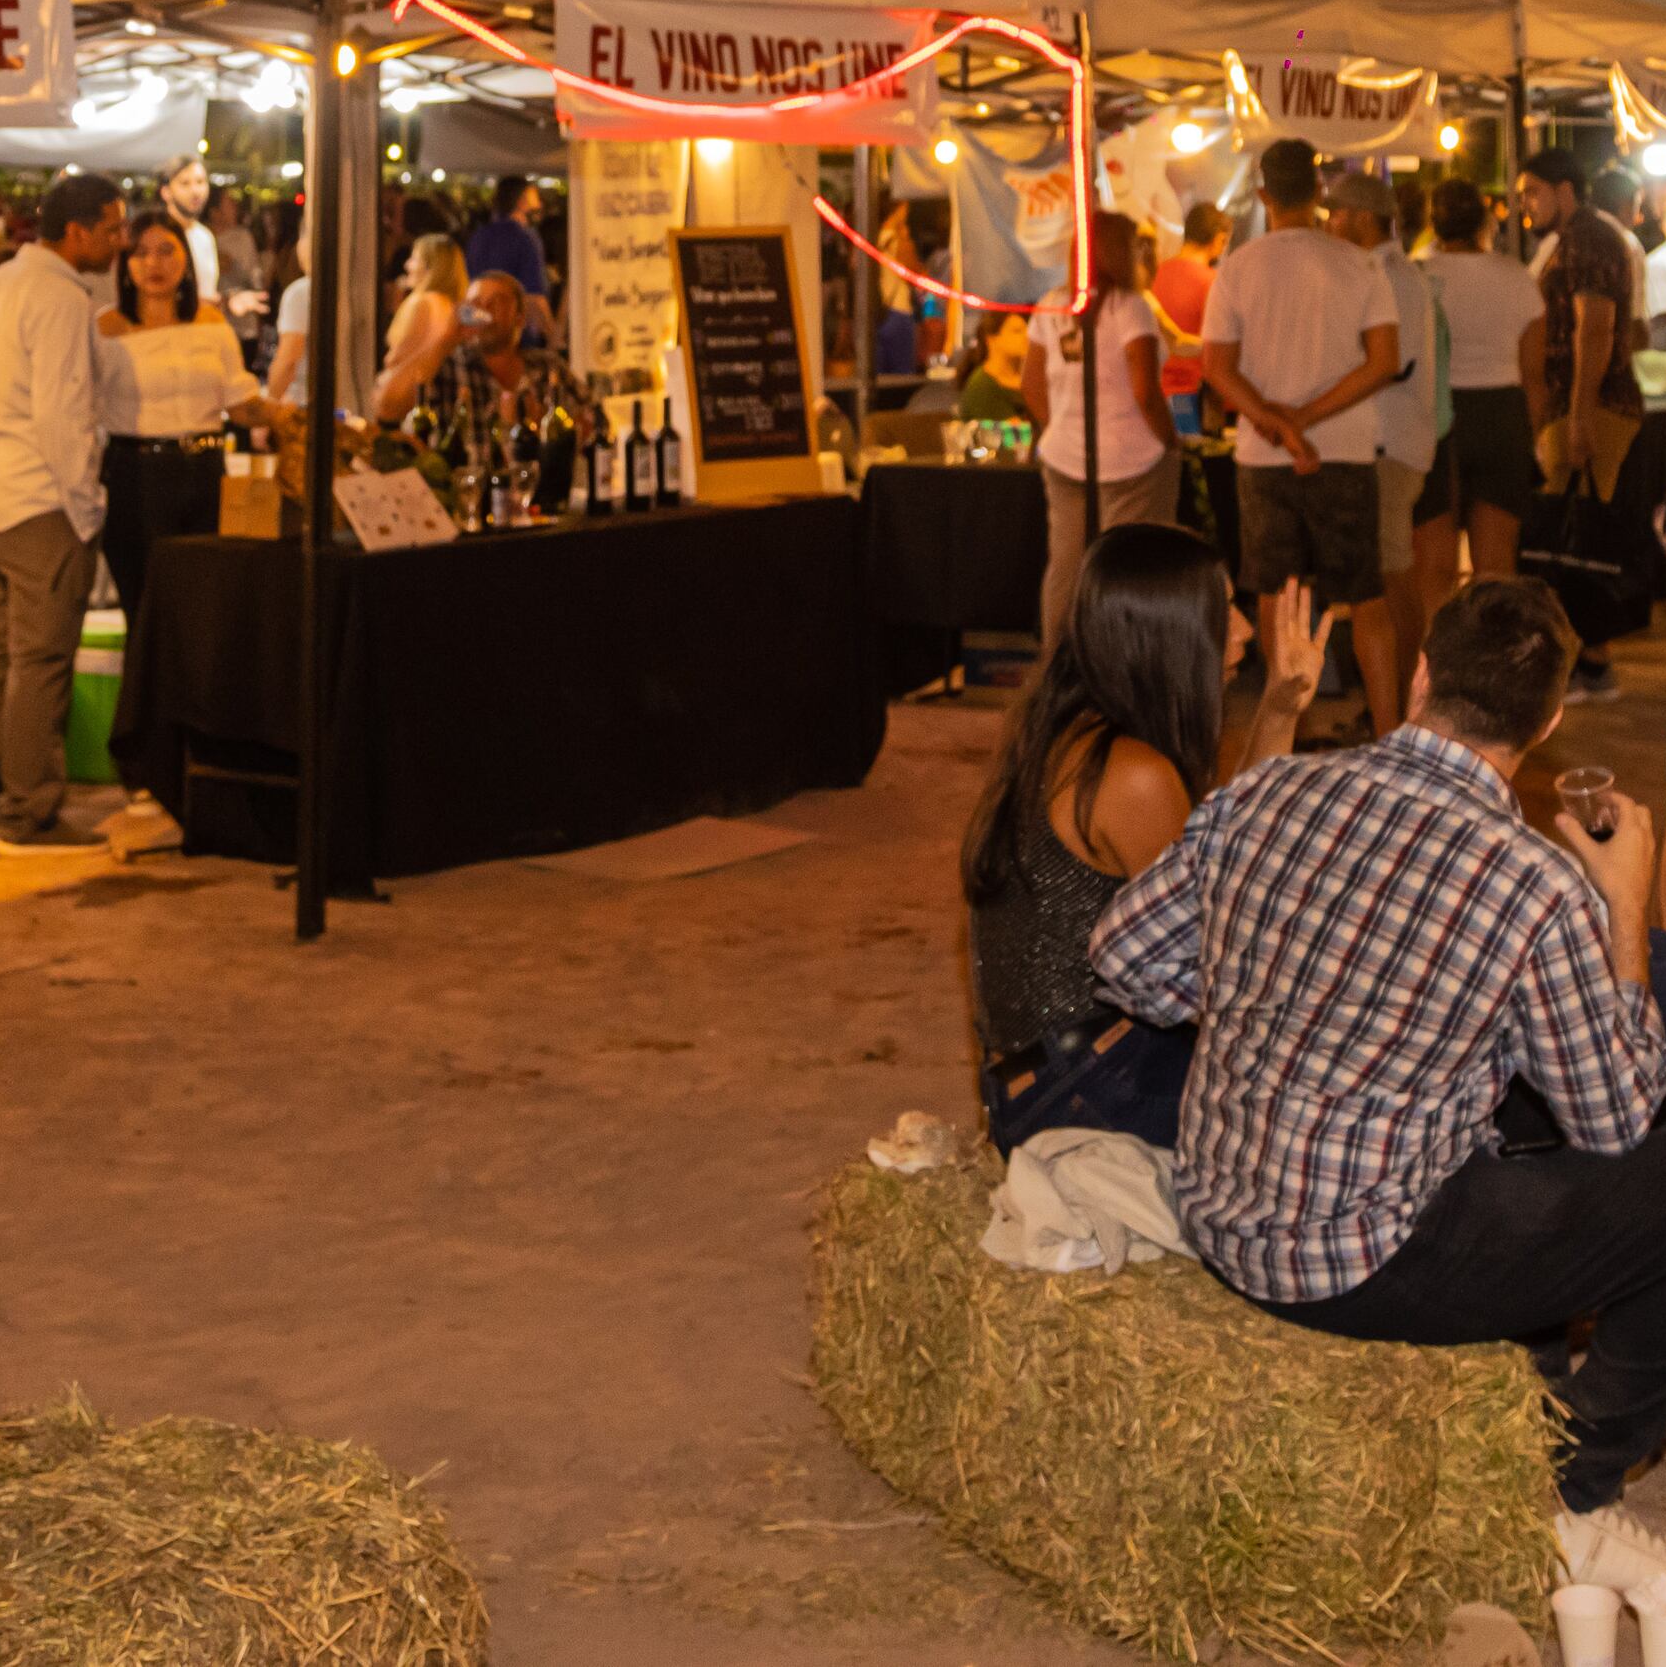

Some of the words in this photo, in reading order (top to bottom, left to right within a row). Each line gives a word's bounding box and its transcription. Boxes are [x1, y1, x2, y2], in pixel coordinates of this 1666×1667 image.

[589, 25, 633, 89] EL
[651, 28, 741, 94] VINO
[752, 33, 827, 95] NOS
[835, 39, 906, 99] UNE
[1281, 65, 1335, 118] VINO
